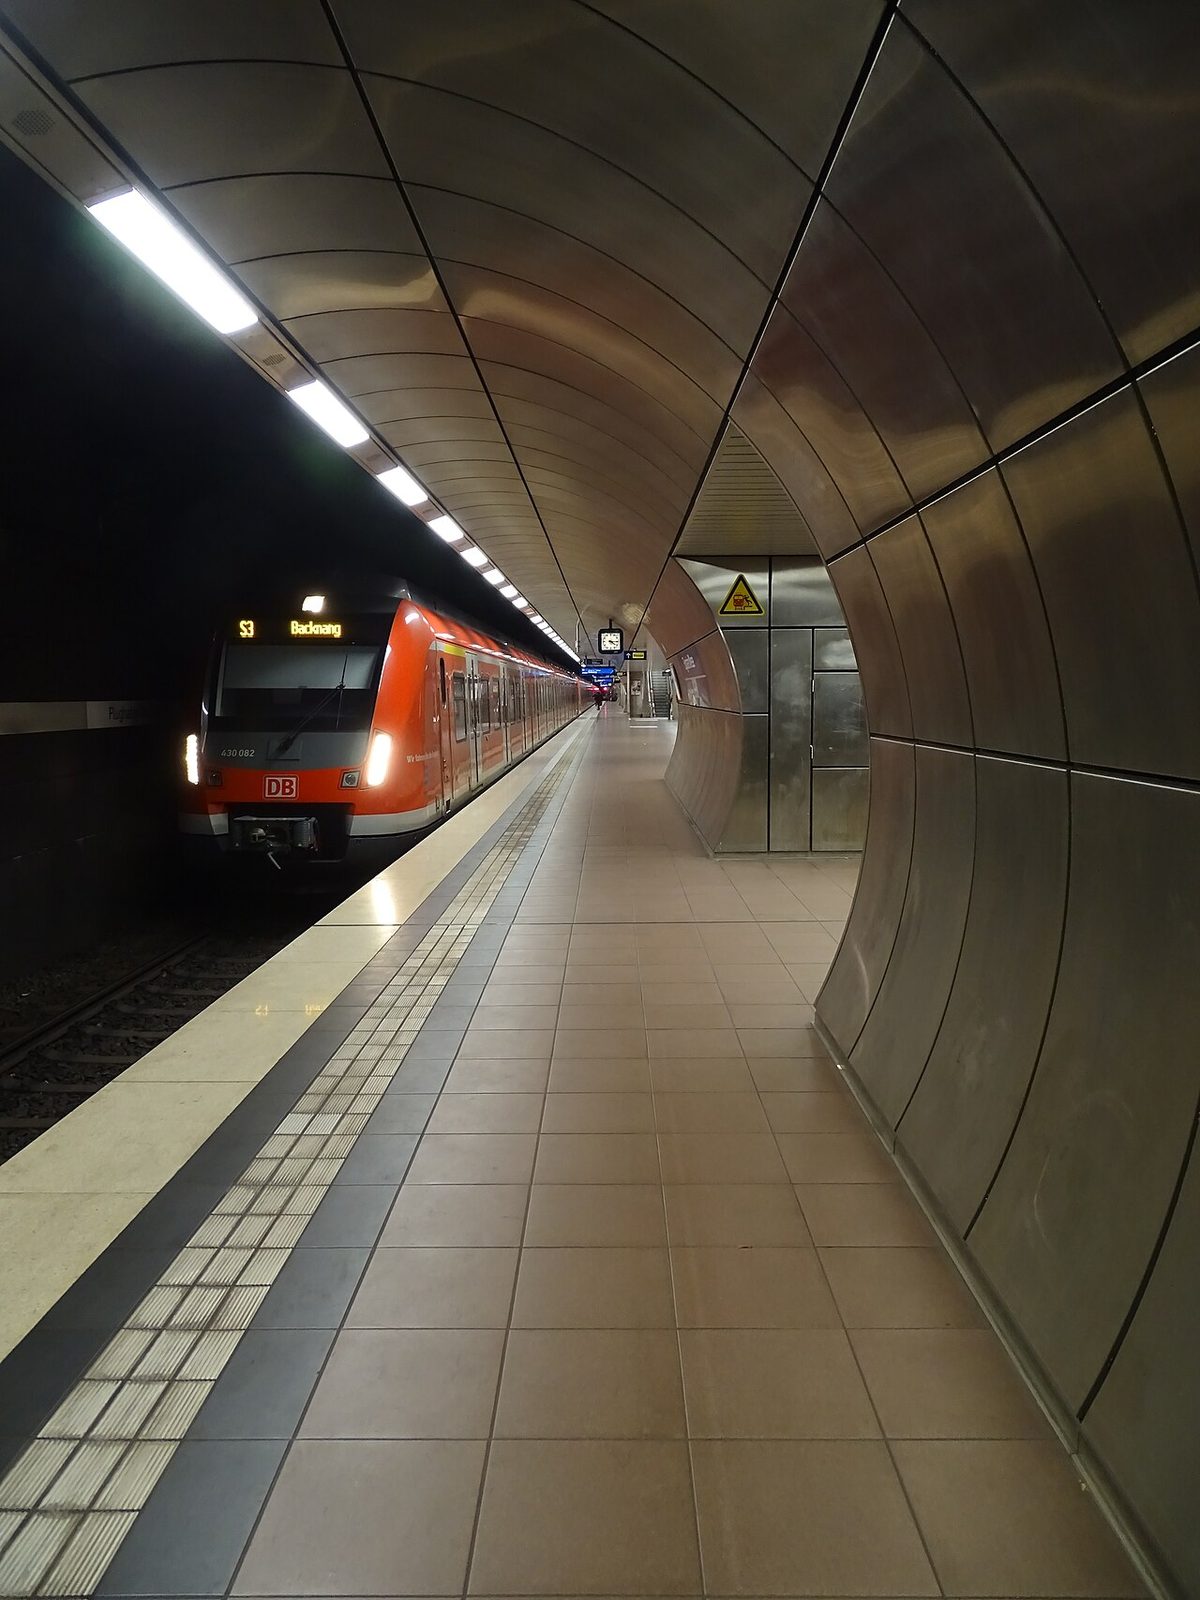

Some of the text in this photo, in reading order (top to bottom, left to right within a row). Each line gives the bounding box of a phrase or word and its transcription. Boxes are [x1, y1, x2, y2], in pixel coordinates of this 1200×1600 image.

[240, 620, 342, 638] S3 Backnang
[221, 749, 255, 757] 430 082
[266, 778, 295, 797] DB
